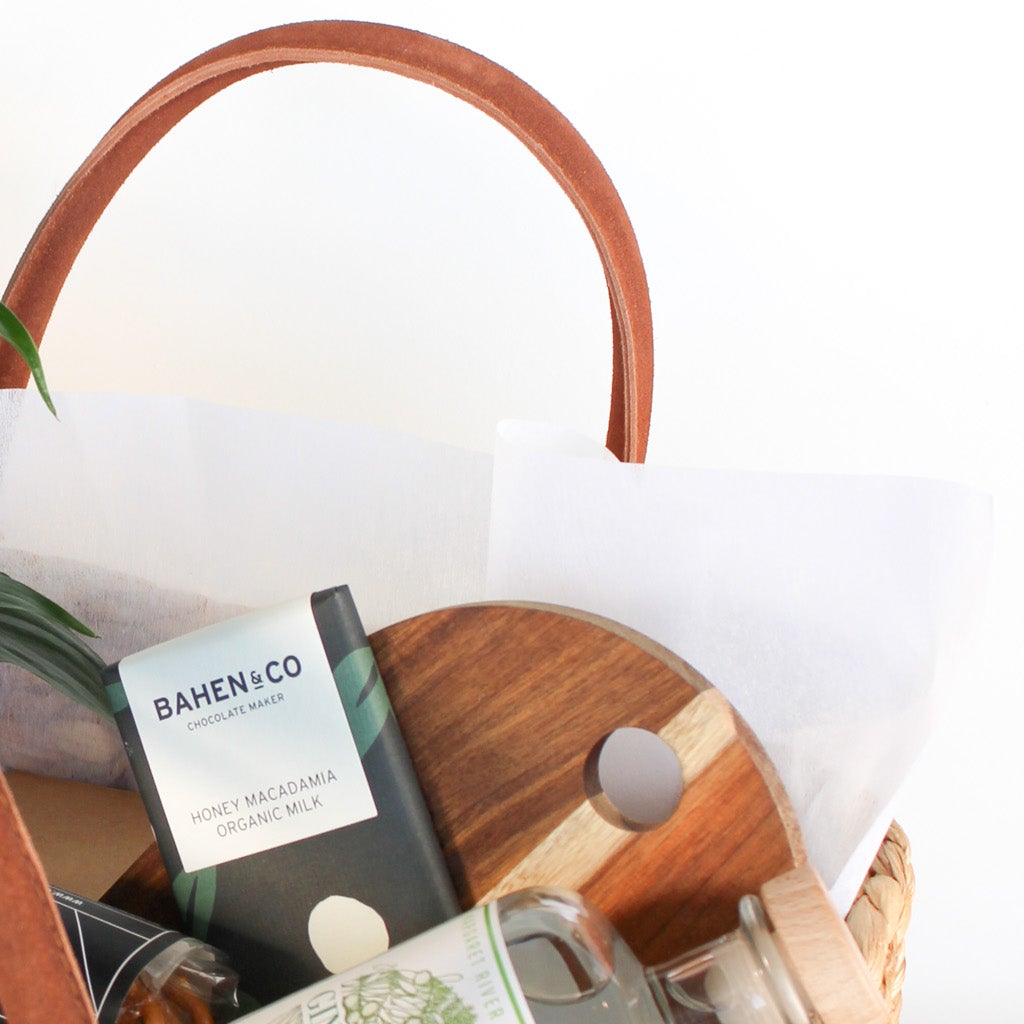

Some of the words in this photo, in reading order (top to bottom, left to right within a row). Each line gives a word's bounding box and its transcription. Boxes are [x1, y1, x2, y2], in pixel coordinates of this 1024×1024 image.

[153, 655, 302, 721] BAHEN&CO
[187, 705, 246, 731] CHOCOLATE
[249, 693, 285, 711] MAKER
[191, 799, 240, 825] HONEY
[245, 769, 338, 808] MACADAMIA
[217, 807, 283, 838] ORGANIC
[286, 795, 324, 817] MILK
[475, 970, 504, 1021] RIVER
